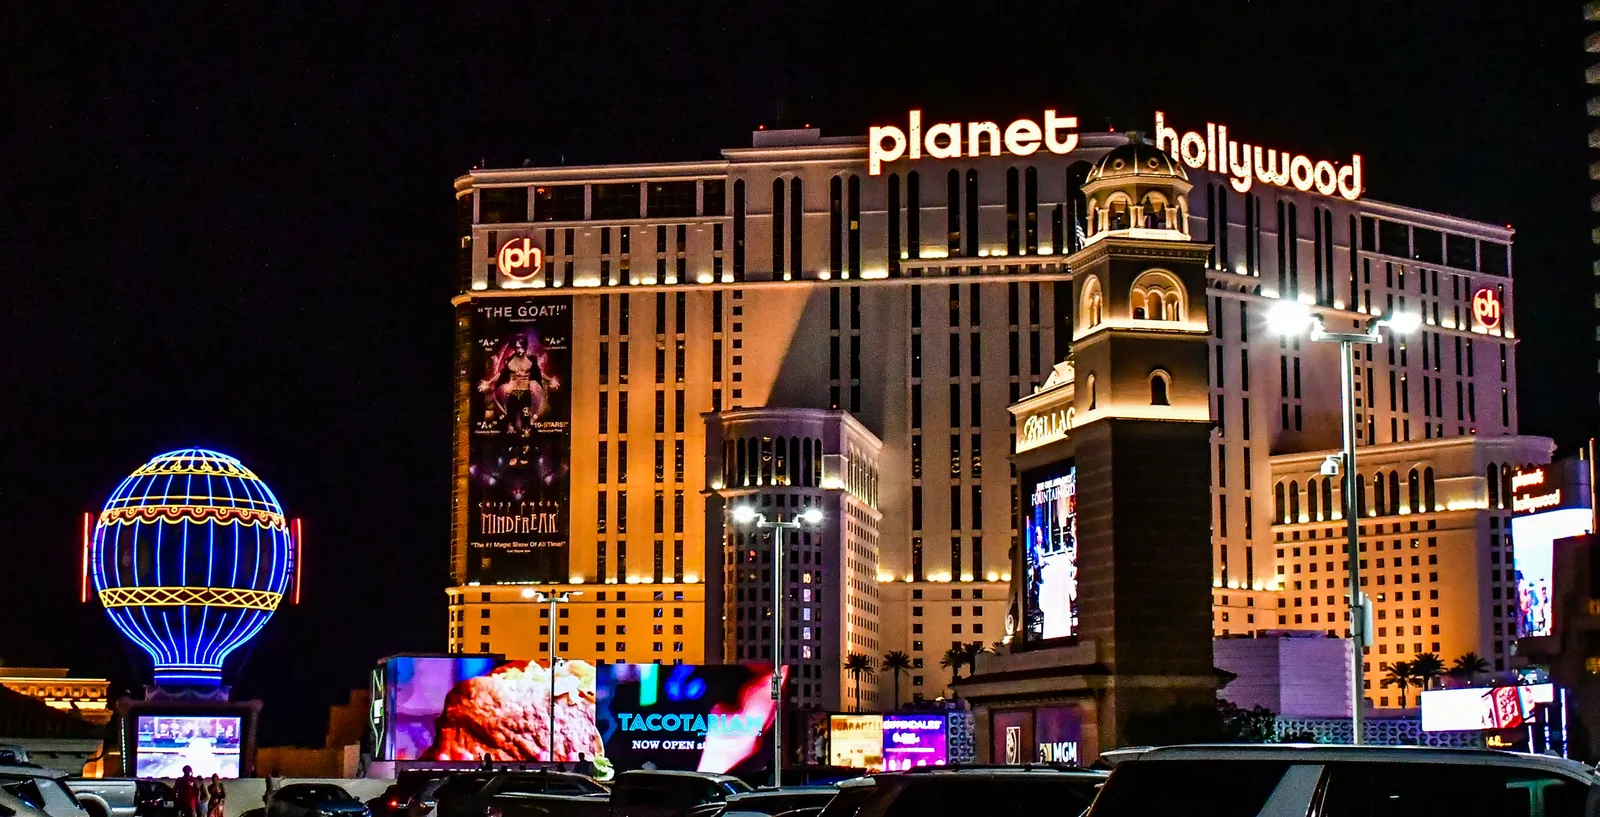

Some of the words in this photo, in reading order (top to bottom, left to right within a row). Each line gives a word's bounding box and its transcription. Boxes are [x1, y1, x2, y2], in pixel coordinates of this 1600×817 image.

[869, 109, 1079, 176] planet
[1155, 111, 1362, 200] hollywood
[504, 237, 542, 274] ph
[477, 306, 513, 318] "THE
[517, 304, 567, 317] GOAT!"
[1474, 289, 1500, 322] ph
[481, 513, 557, 534] MINDFREAK
[618, 712, 763, 732] TACOTARIAN
[632, 740, 660, 750] NOW
[662, 740, 695, 750] OPEN
[1053, 741, 1077, 763] MGM
